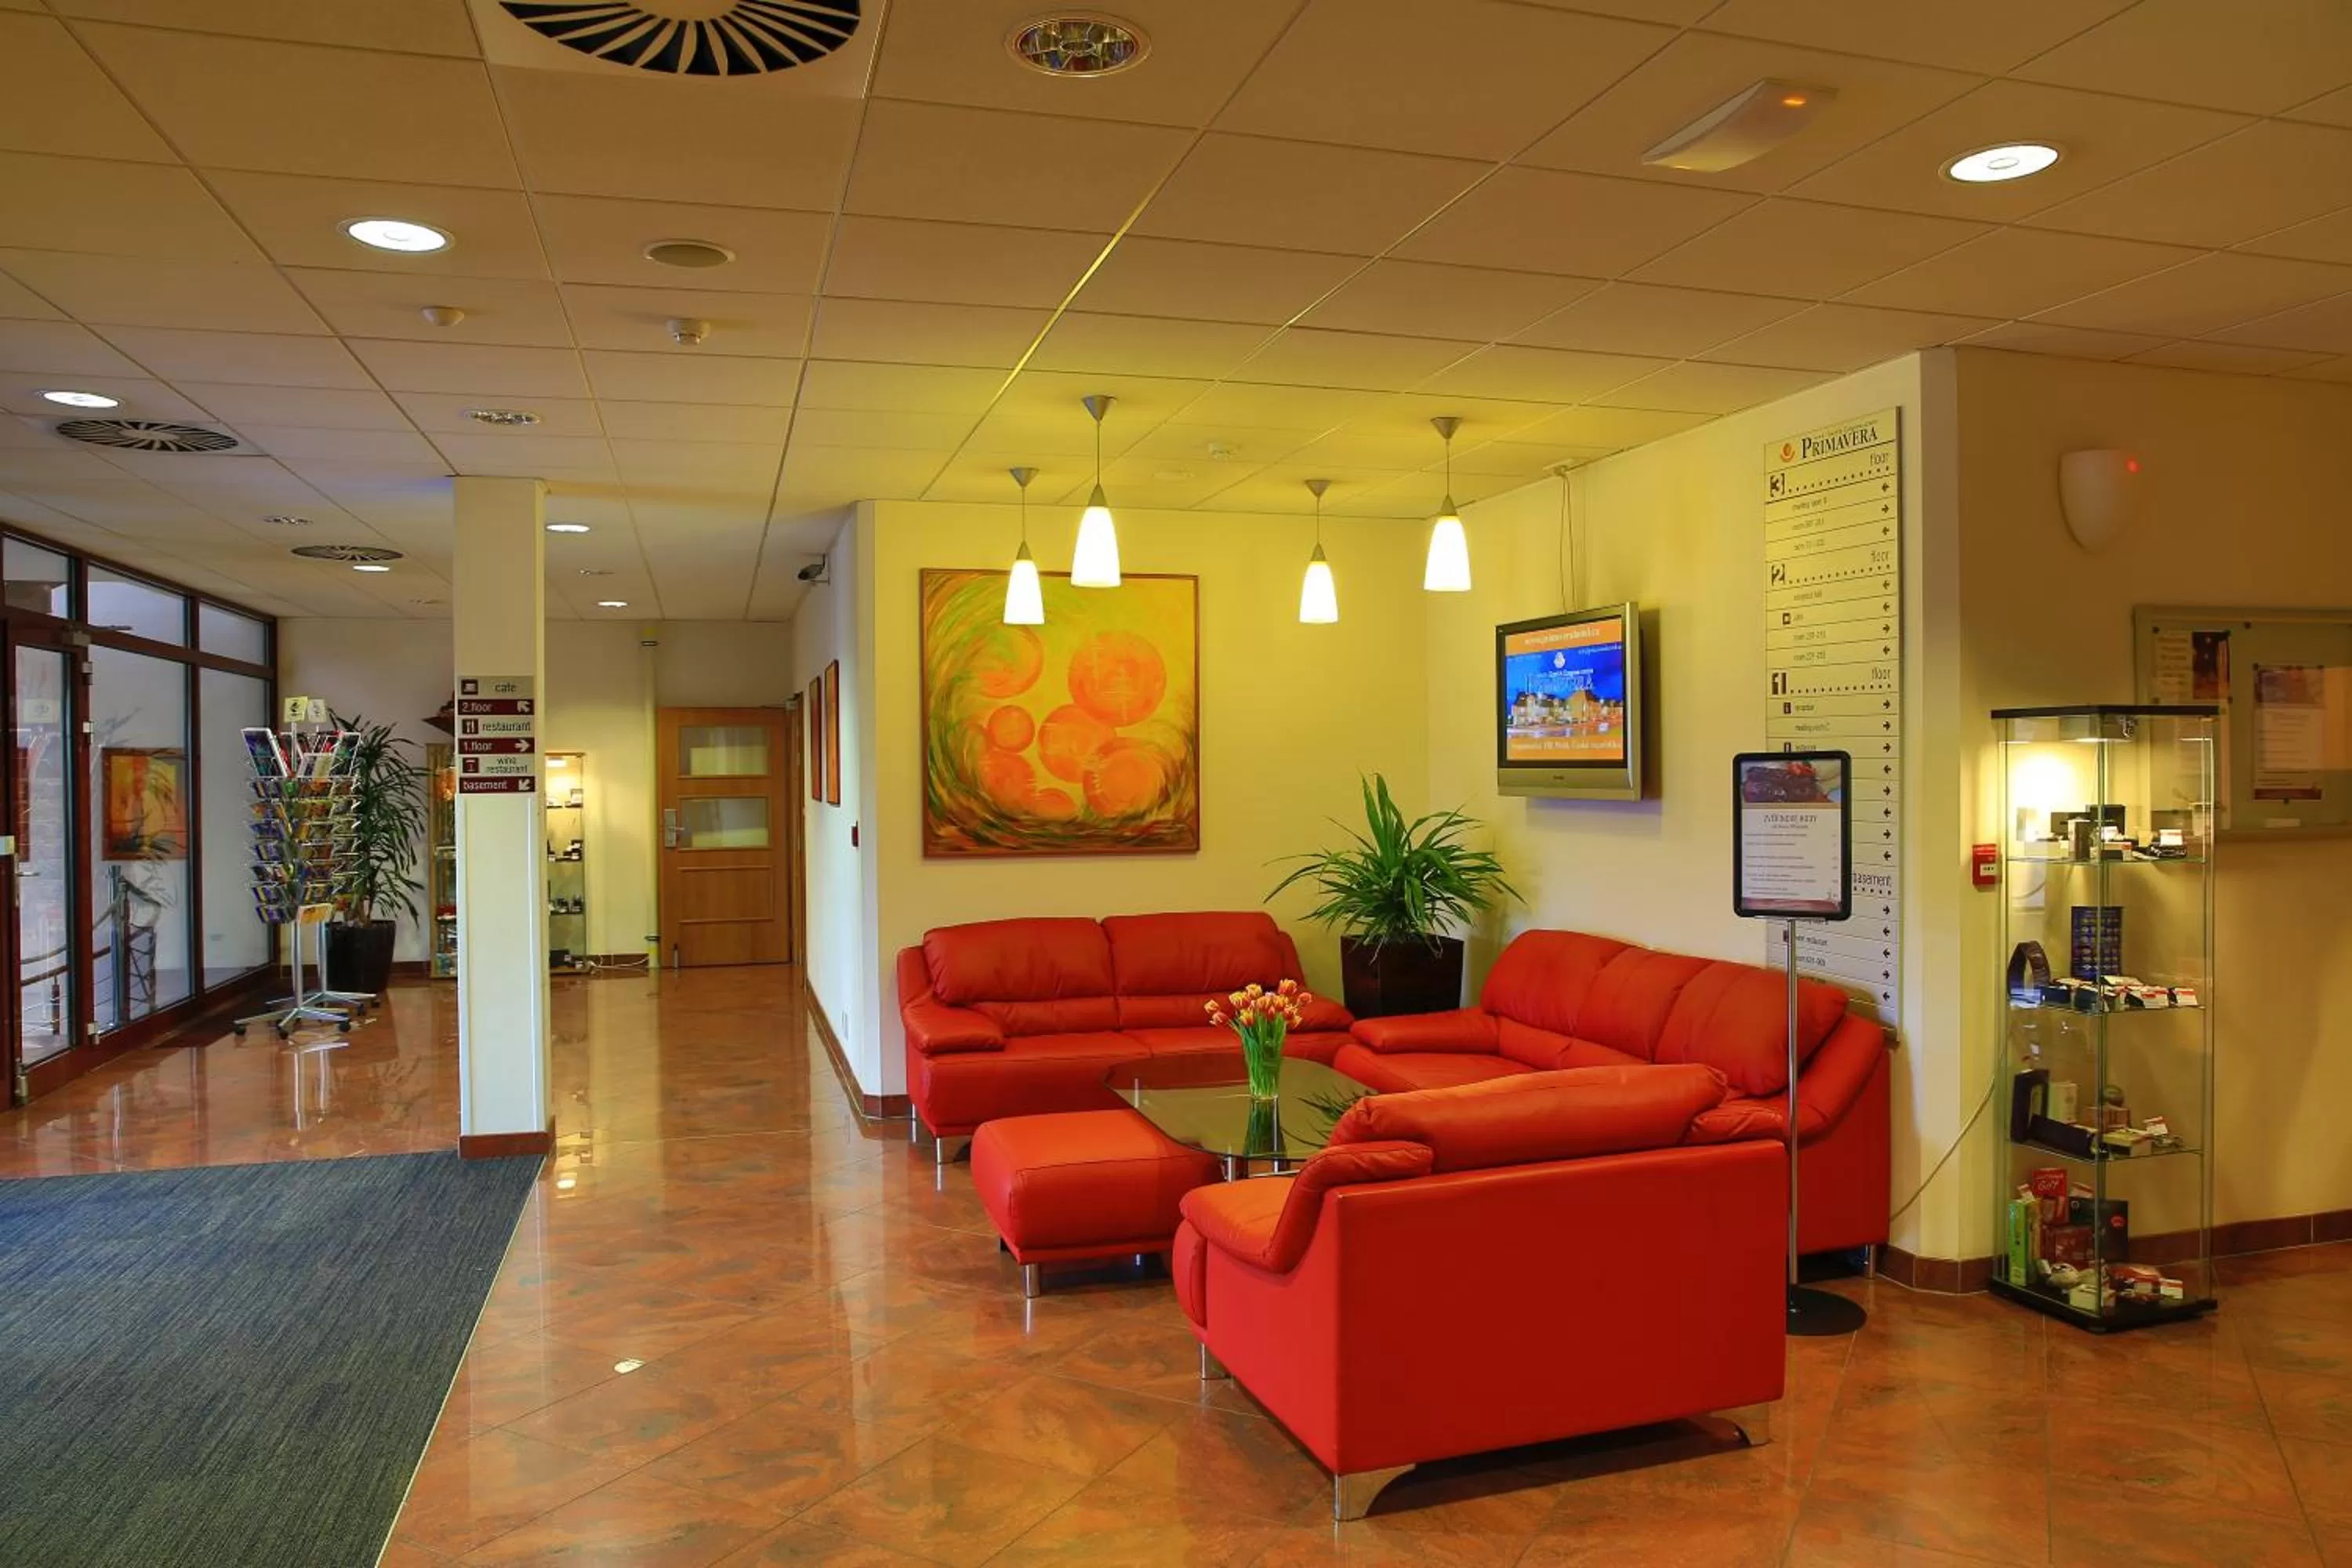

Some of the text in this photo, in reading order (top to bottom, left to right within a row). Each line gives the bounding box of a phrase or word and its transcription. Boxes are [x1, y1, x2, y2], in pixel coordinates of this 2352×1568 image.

[1801, 426, 1878, 459] PRIMAVERA
[495, 683, 517, 694] cafe
[482, 721, 531, 731] restaurant
[463, 780, 508, 789] basement
